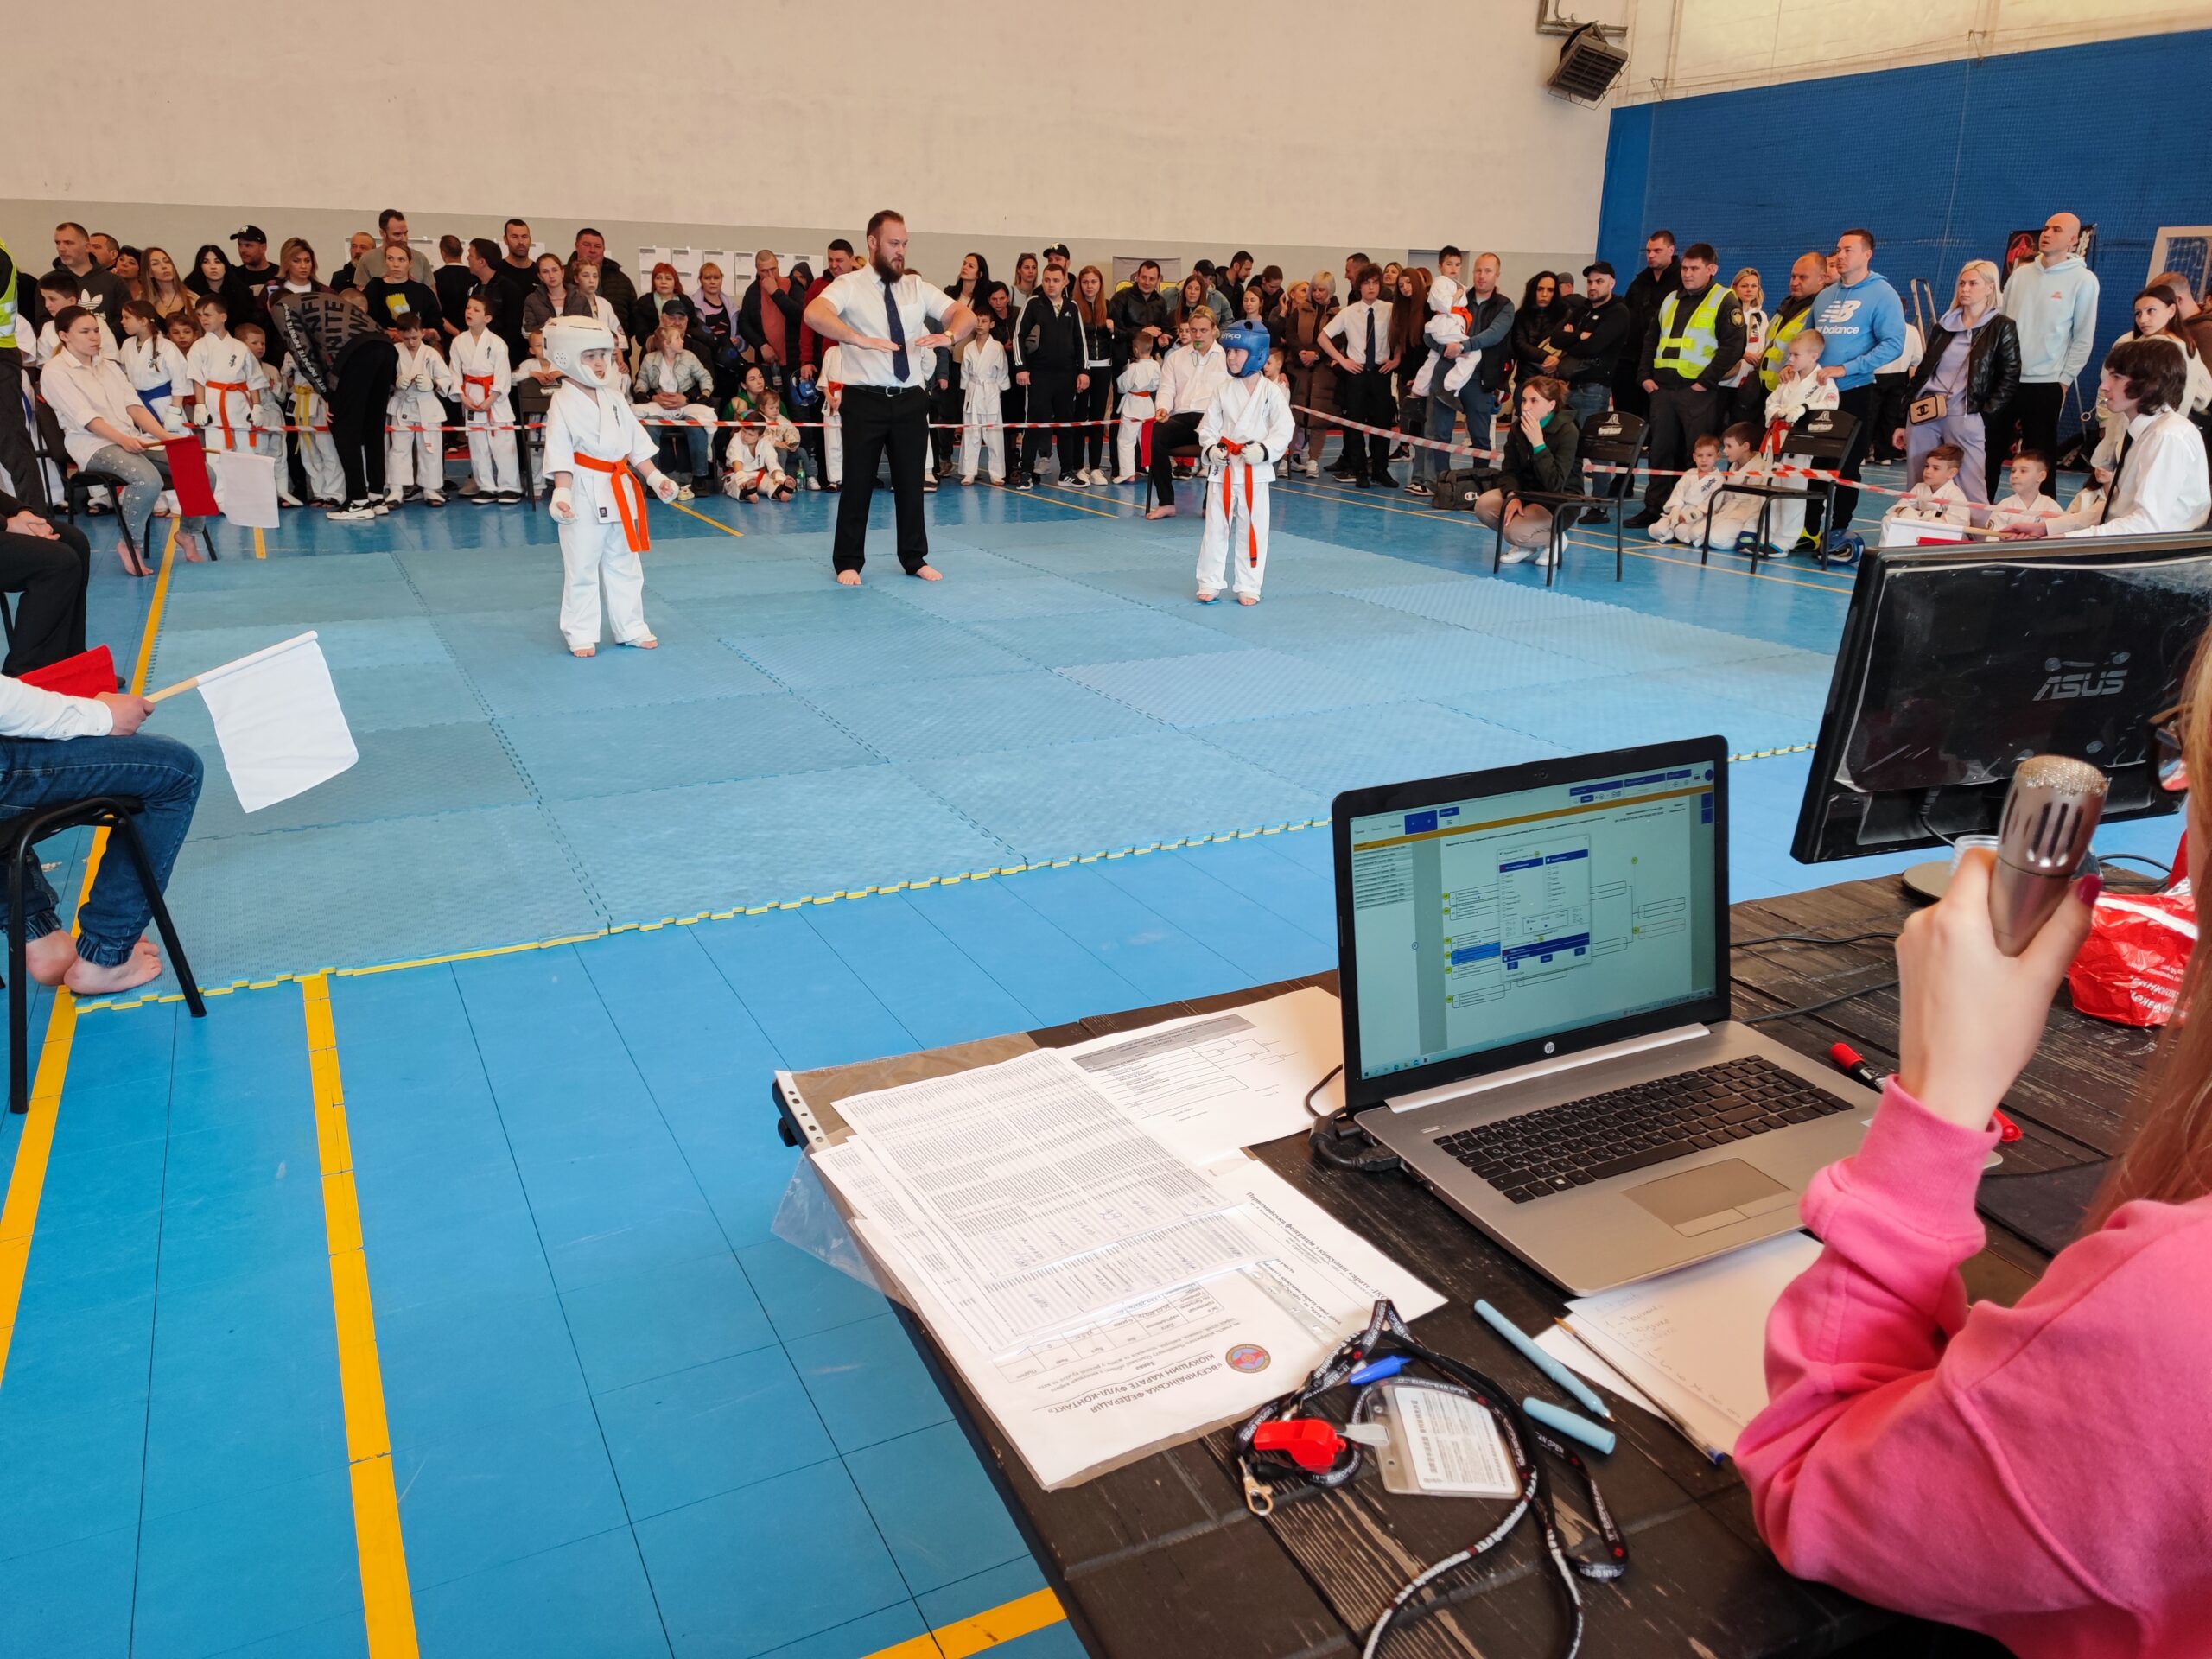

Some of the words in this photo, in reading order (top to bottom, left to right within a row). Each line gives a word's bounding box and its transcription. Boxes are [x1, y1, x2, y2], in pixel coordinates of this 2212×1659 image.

[1822, 325, 1860, 334] balance
[2032, 669, 2128, 701] ASUS
[1163, 1352, 1216, 1376] КІОКУШИН
[1128, 1370, 1165, 1390] КАРАТЕ
[1144, 1361, 1224, 1396] «ВСЕУКРАЇНСЬКА
[1411, 1378, 1449, 1390] EUROPEAN
[1449, 1385, 1469, 1395] OPEN
[1046, 1384, 1128, 1415] ФУЛЛ-КОНТАКТ»
[1089, 1390, 1146, 1414] ФЕДЕРАЦІЯ
[1547, 1439, 1565, 1454] OPEN
